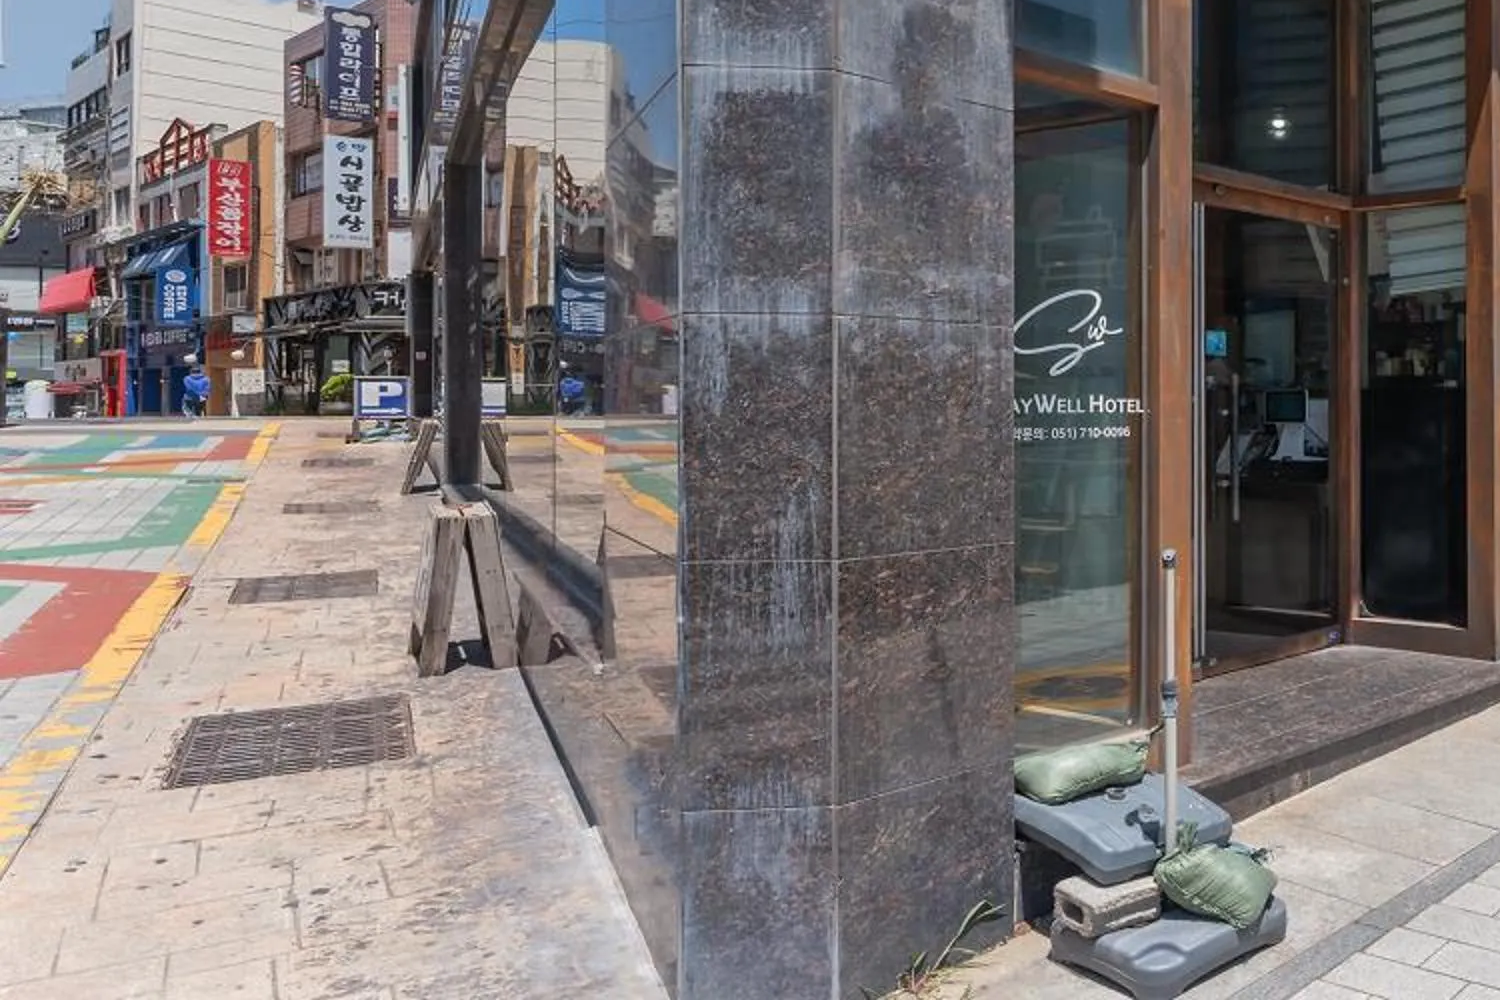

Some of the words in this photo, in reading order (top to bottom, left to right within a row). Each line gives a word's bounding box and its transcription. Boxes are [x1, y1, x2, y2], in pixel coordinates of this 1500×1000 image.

[336, 155, 366, 233] 시골밥상
[361, 382, 403, 407] P
[1089, 394, 1144, 414] HOTEL
